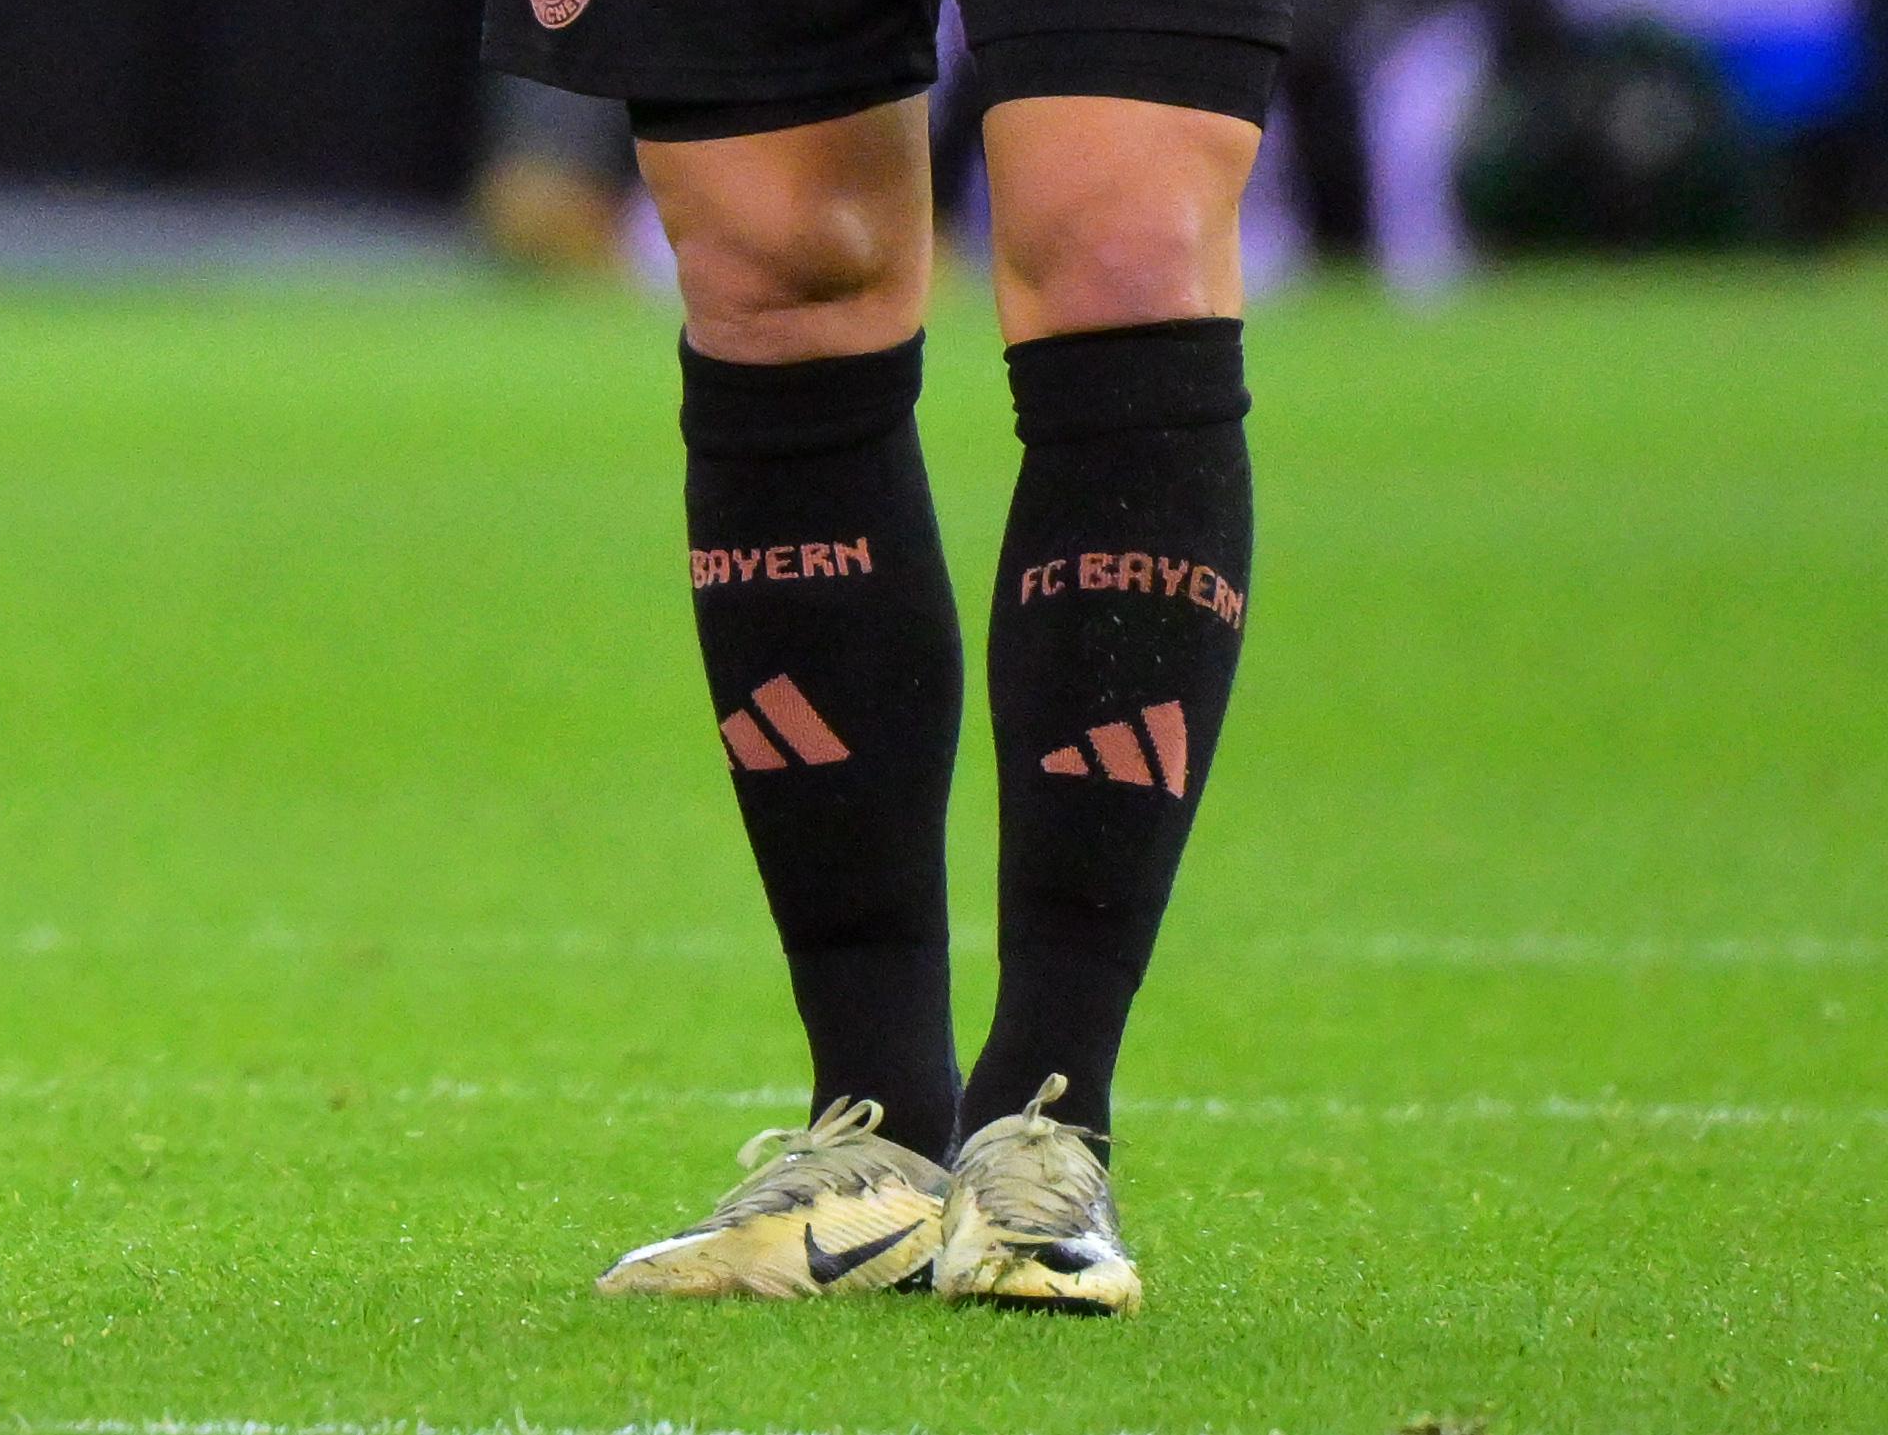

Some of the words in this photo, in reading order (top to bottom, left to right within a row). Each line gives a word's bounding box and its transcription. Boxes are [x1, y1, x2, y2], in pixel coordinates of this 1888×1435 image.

[689, 536, 872, 589] BAYERN
[1021, 559, 1066, 605] FC
[1080, 552, 1244, 629] BAYERN
